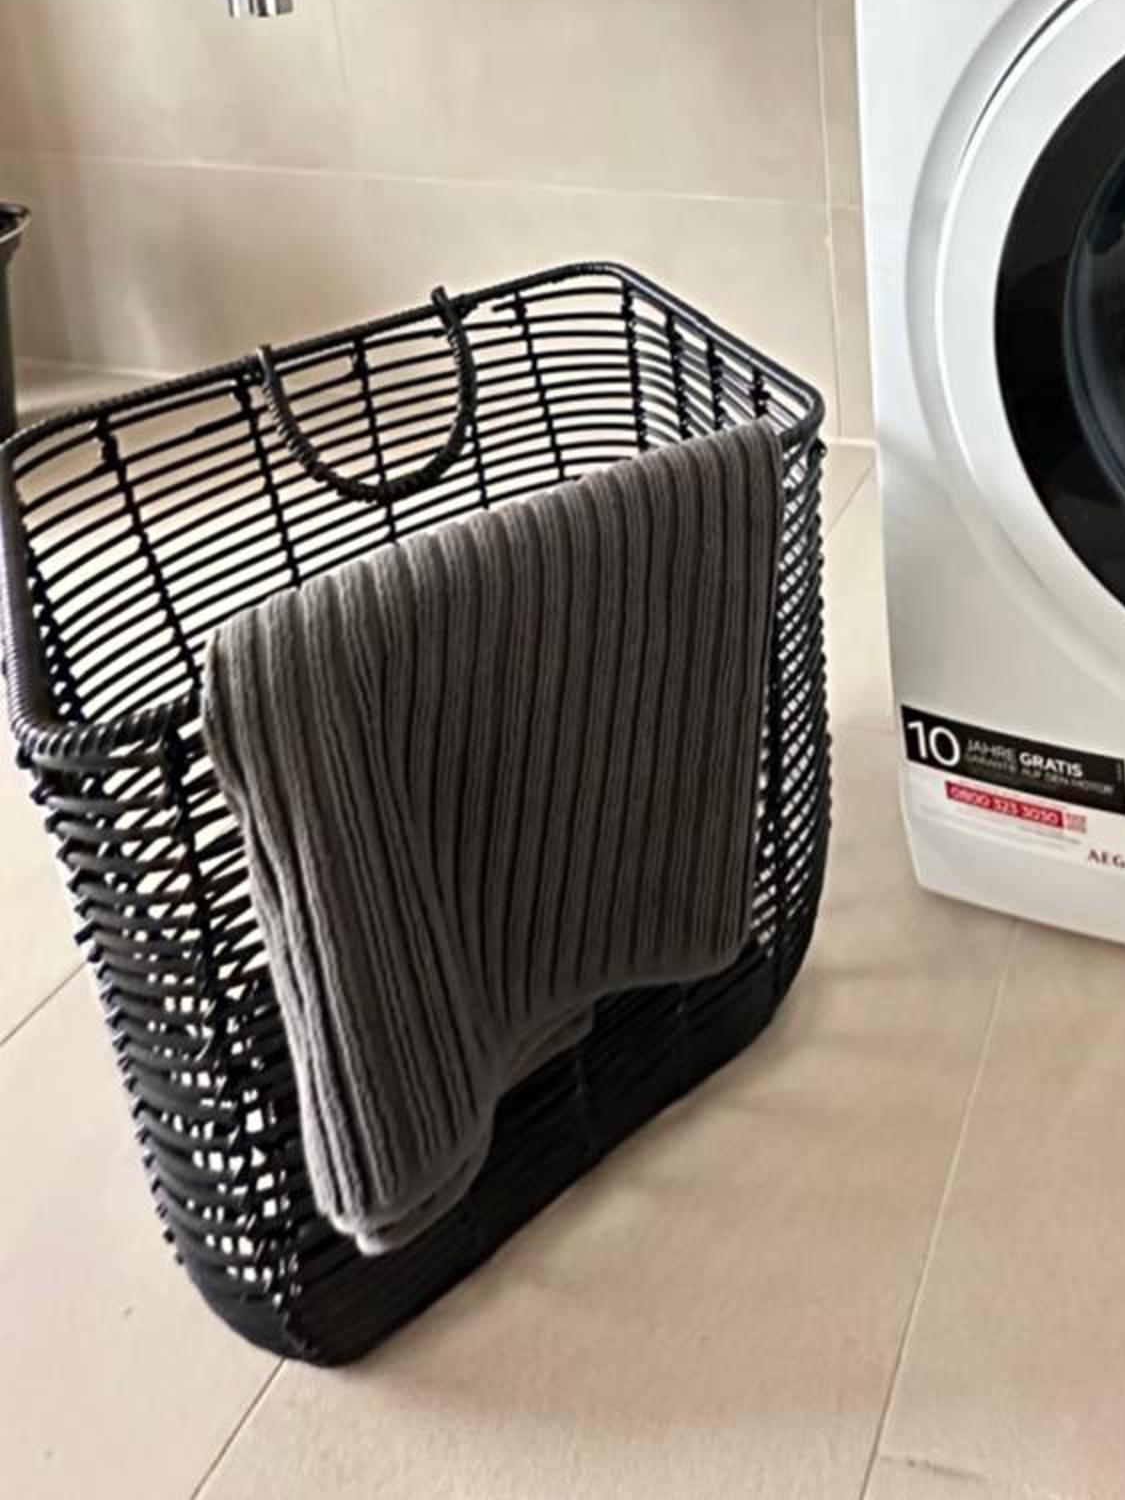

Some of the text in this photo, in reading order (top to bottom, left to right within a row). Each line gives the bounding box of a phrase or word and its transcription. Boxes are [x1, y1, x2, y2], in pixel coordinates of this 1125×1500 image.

[907, 719, 961, 768] 10
[966, 738, 1083, 778] JAHRE GRATIS
